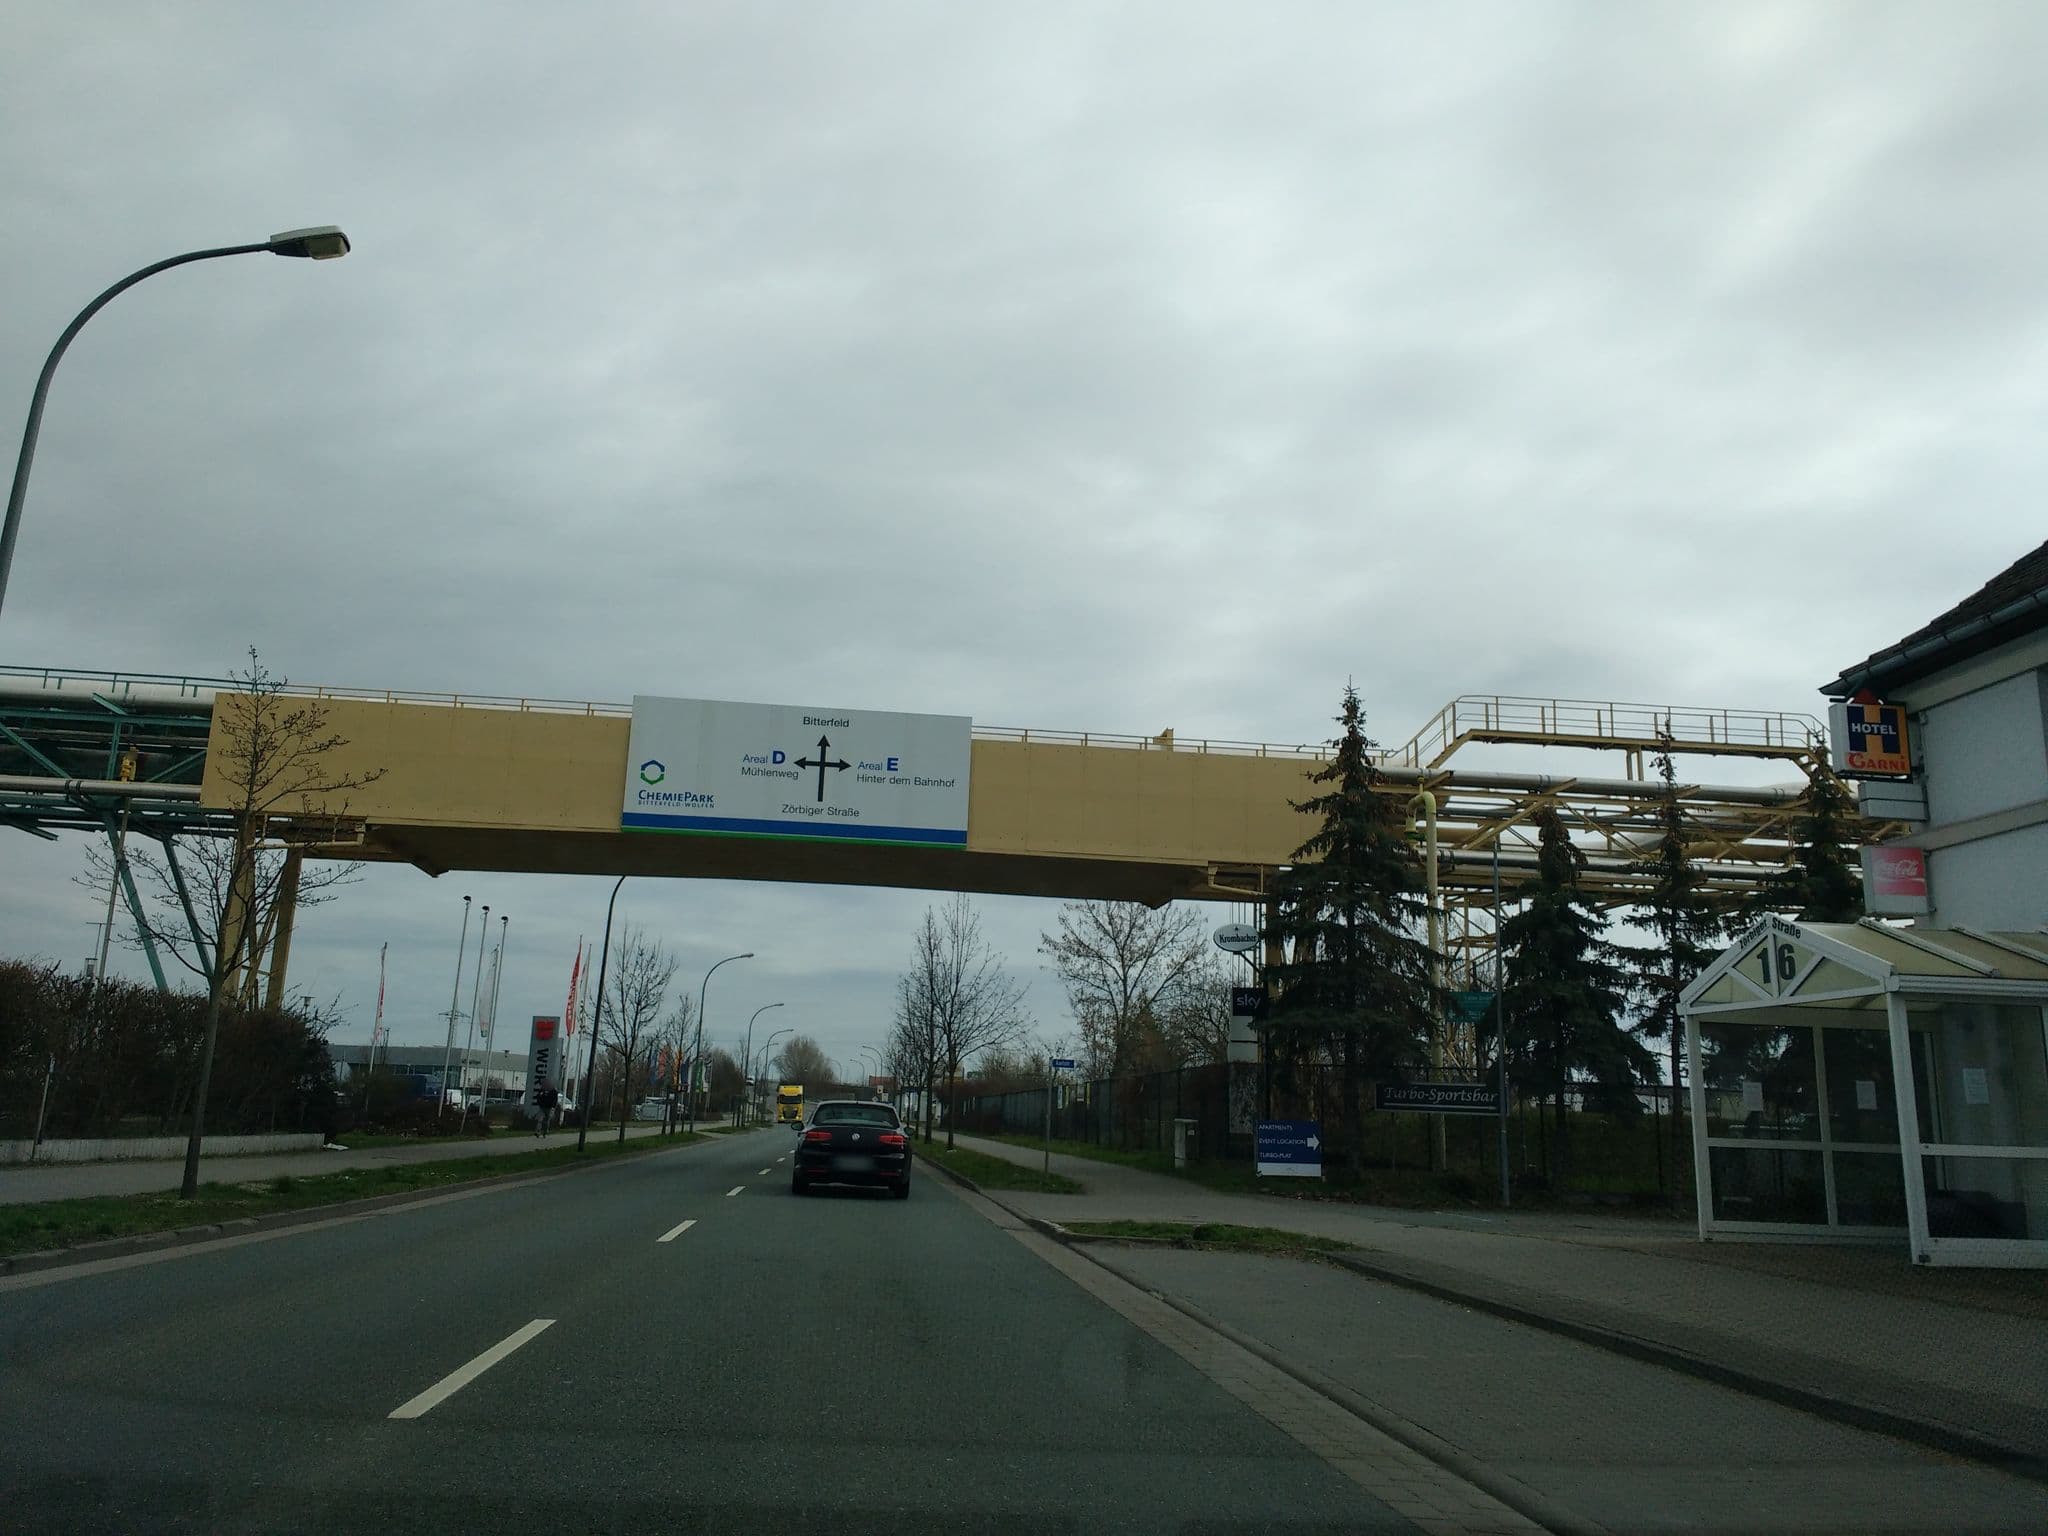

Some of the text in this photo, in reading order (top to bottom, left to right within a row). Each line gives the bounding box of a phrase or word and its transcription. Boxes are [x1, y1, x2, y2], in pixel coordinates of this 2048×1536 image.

[803, 716, 850, 728] Bitterfeld
[1850, 722, 1898, 736] HOTEL
[742, 750, 786, 765] Areal D
[857, 757, 899, 772] Areal E
[741, 766, 799, 781] Mühlenweg
[856, 773, 956, 788] Hinter dem Bahnhof
[781, 803, 860, 818] Zörbiger Straße
[1771, 917, 1802, 940] Straße
[1218, 932, 1257, 944] Krombacher
[1756, 942, 1797, 985] 16
[1235, 993, 1261, 1009] sky
[531, 1047, 550, 1106] WÜR
[1384, 1086, 1499, 1105] Turbo-Sportsbar
[1258, 1123, 1293, 1132] APARTMENTS
[1258, 1137, 1306, 1146] EVENT LOCATION
